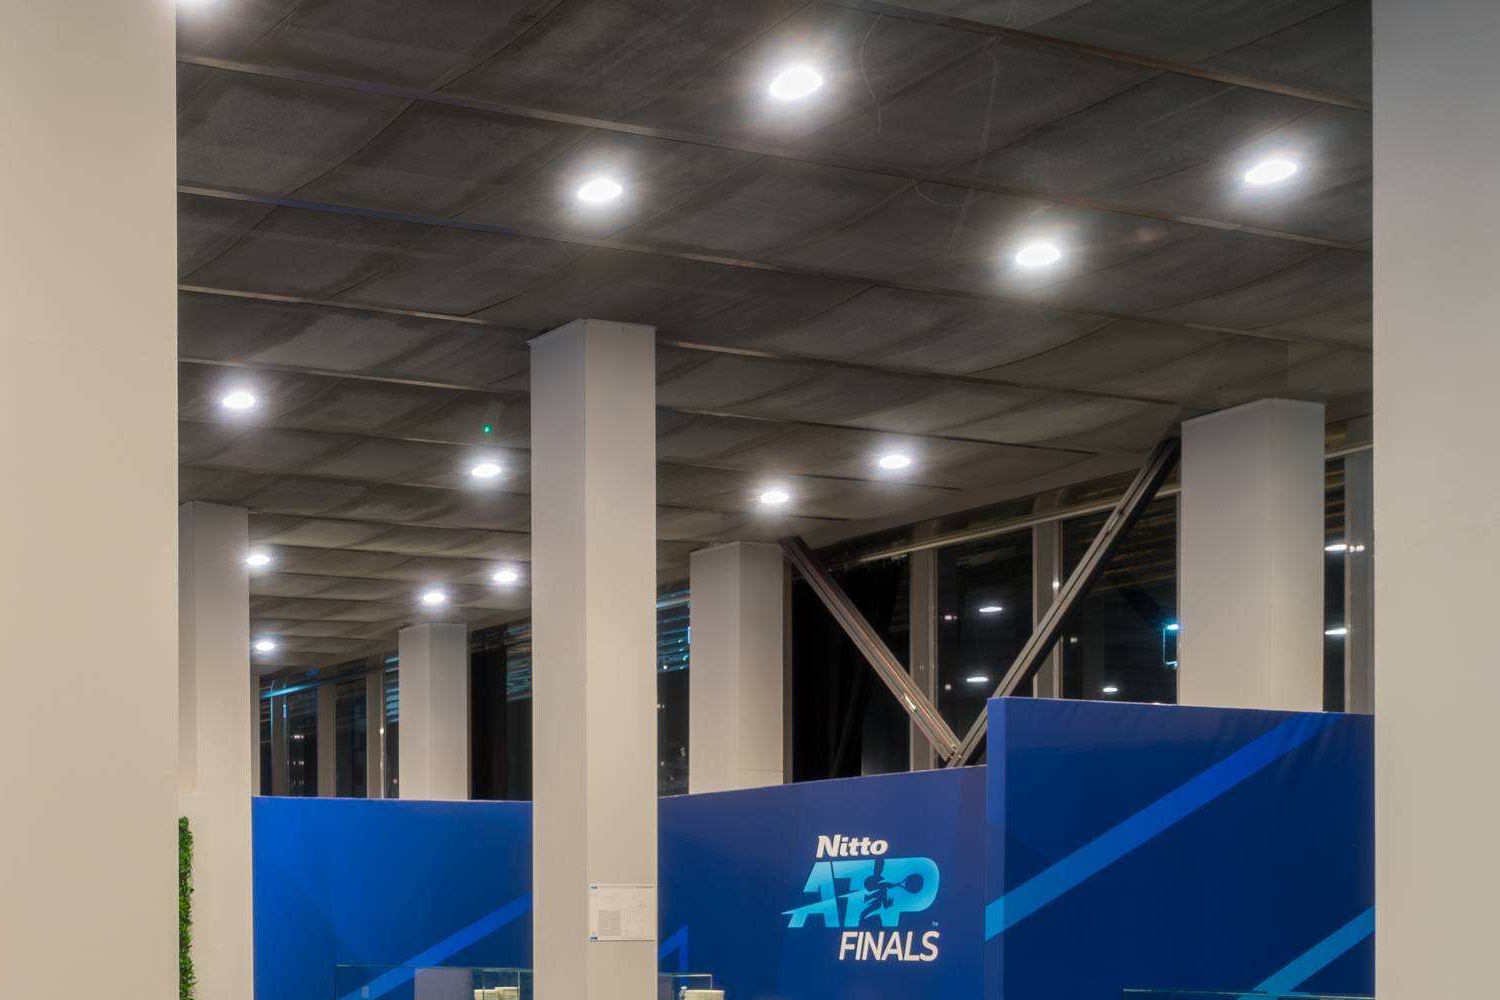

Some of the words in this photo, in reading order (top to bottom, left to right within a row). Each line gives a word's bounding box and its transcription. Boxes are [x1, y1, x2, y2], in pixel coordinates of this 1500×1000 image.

[816, 834, 888, 858] Nitto
[780, 856, 940, 928] ATP
[839, 930, 940, 961] FINALS
